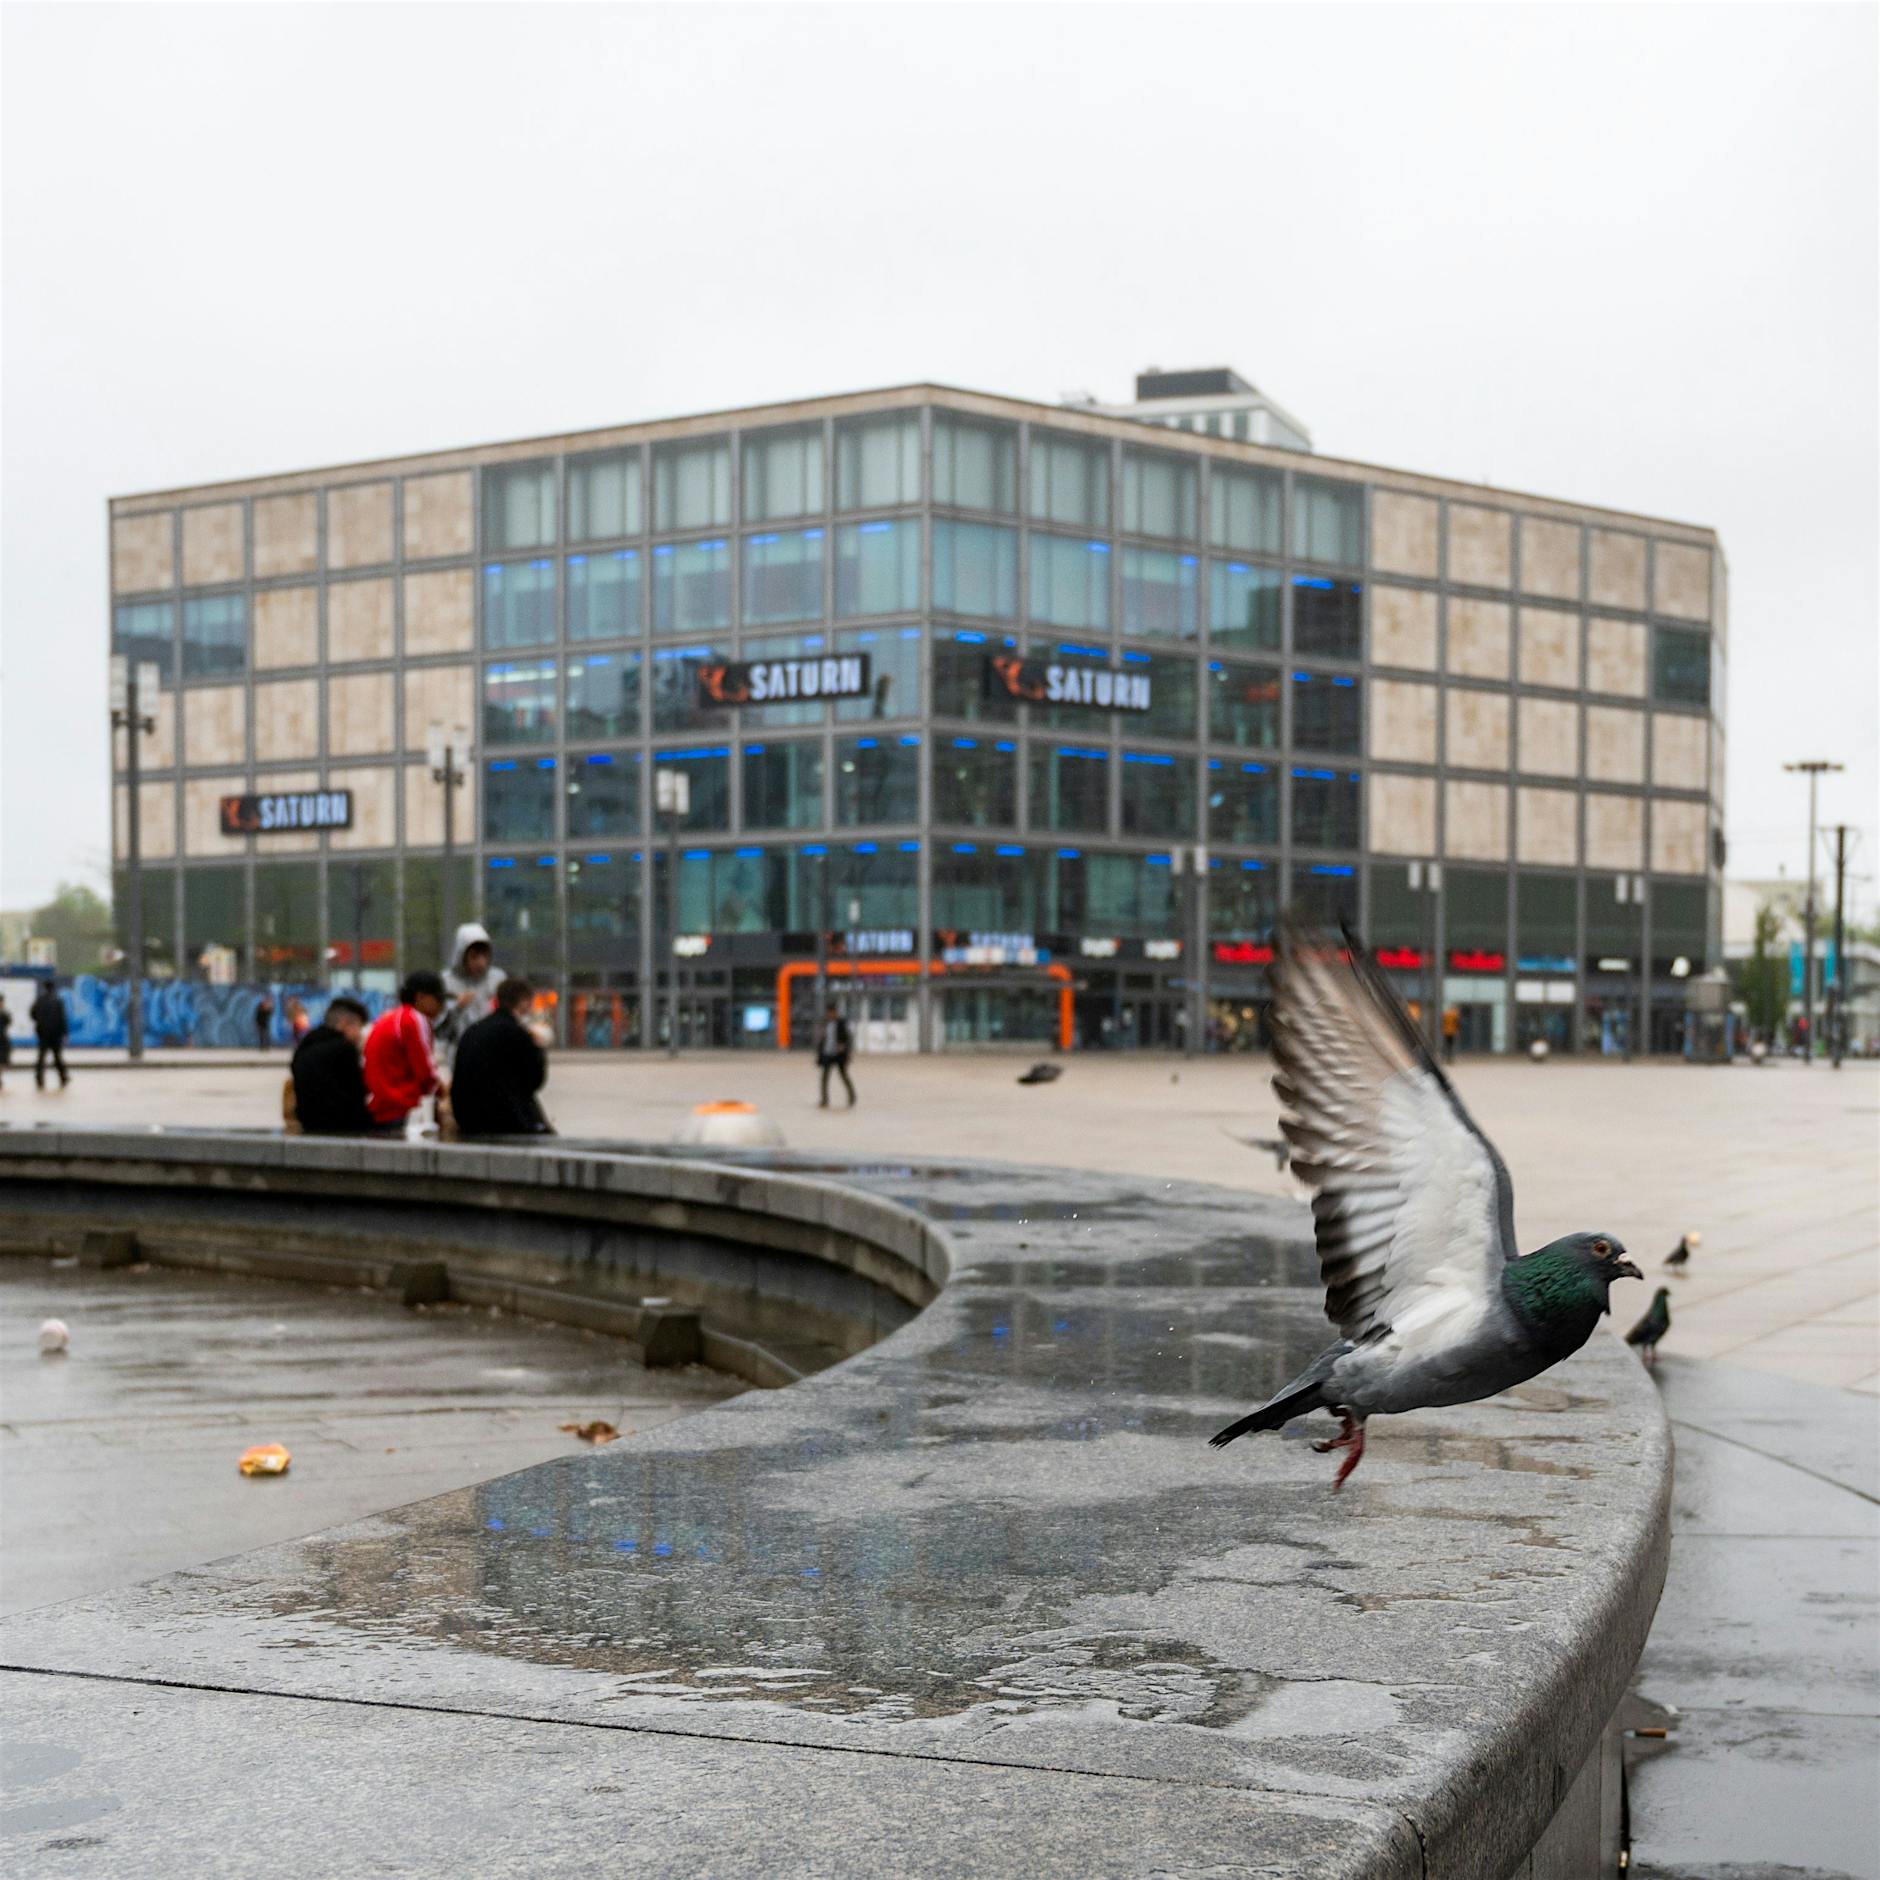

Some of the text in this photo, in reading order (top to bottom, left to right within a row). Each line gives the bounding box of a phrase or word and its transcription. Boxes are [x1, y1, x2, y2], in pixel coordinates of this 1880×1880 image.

[749, 655, 863, 700] SATURN
[1045, 664, 1152, 710] SATURN
[259, 792, 348, 829] SATURN
